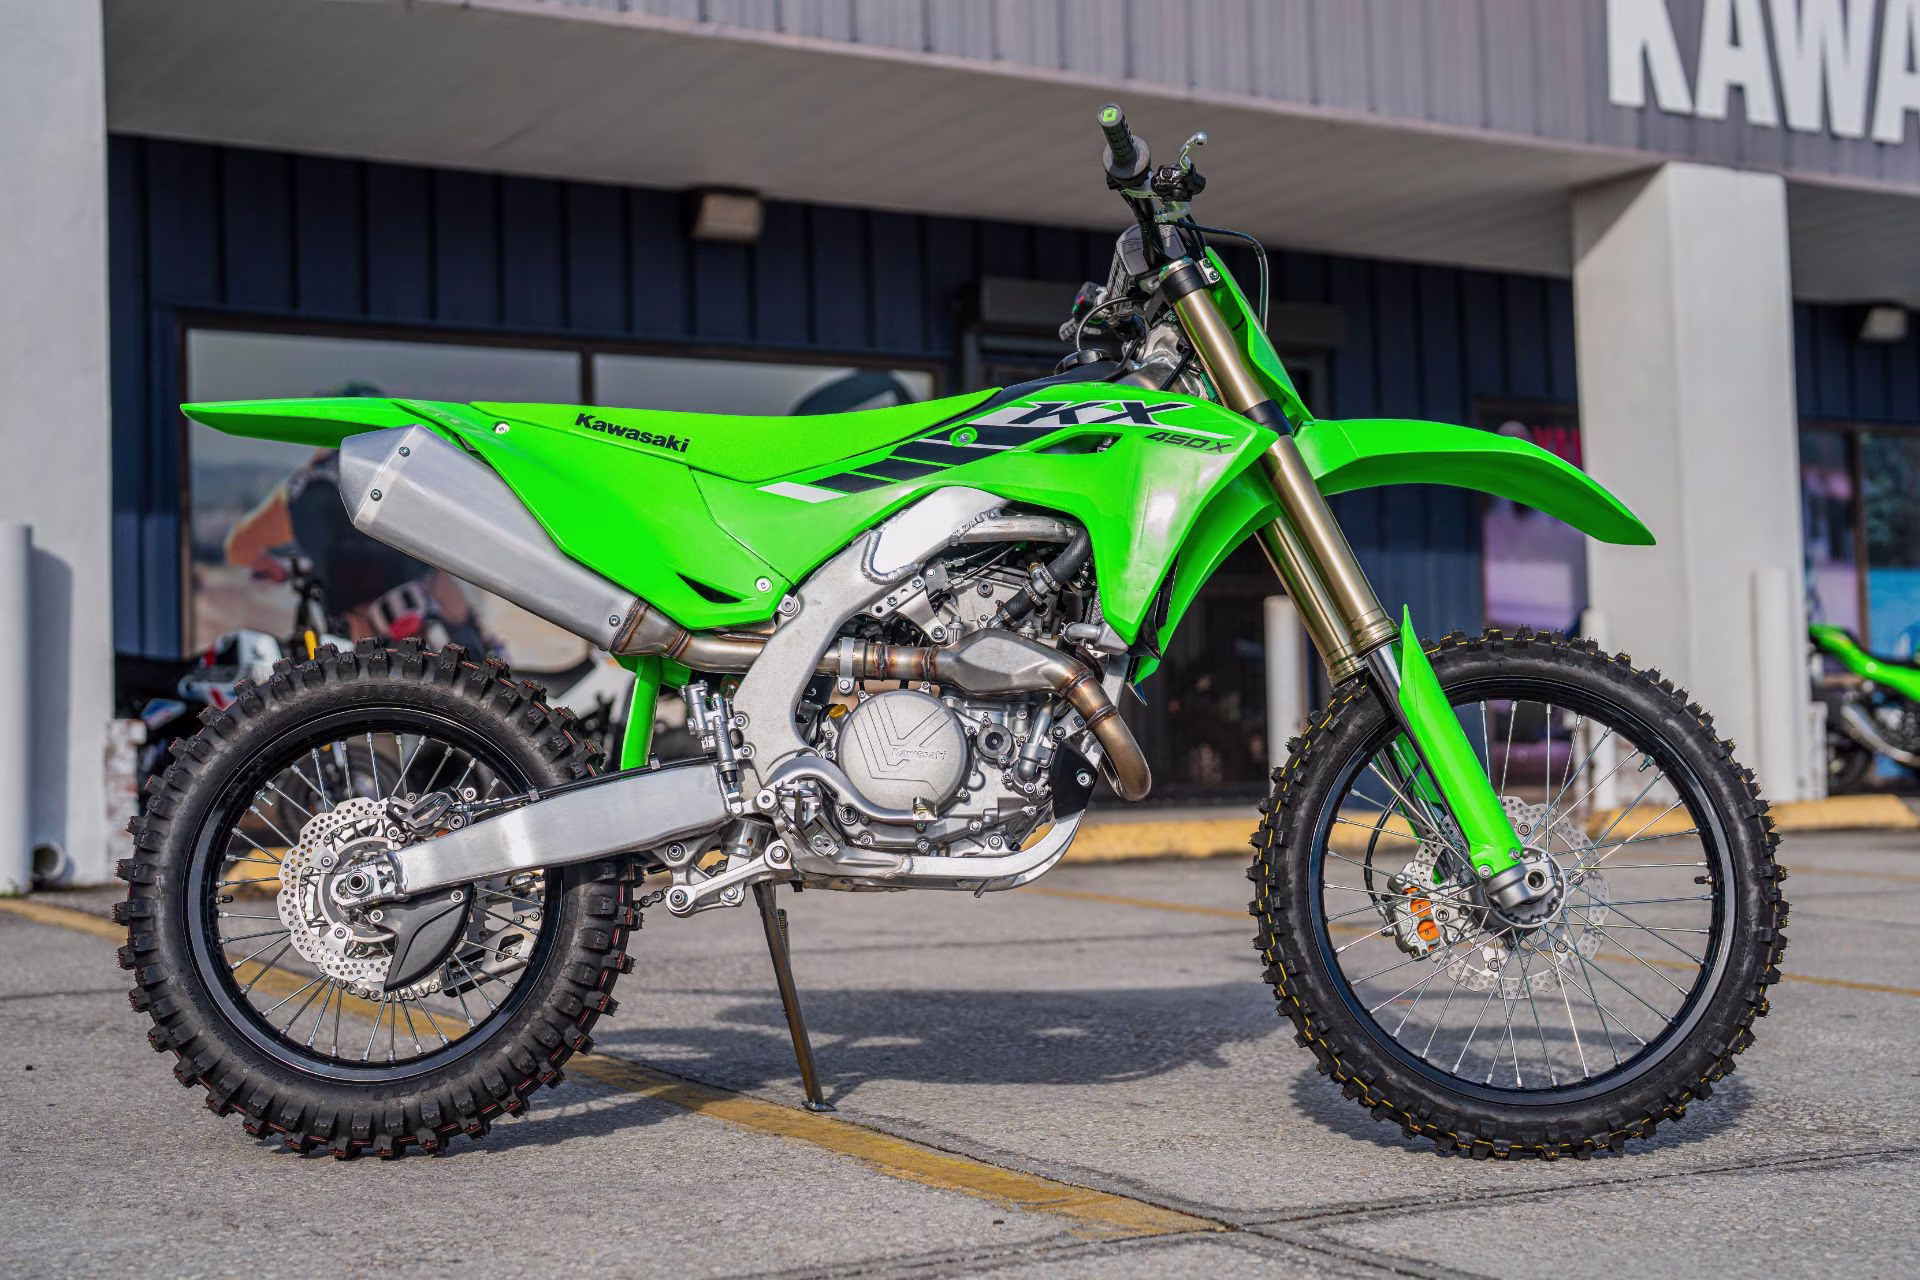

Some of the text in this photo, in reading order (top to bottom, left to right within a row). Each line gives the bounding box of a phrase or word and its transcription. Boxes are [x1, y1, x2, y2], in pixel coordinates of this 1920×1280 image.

[1007, 400, 1197, 426] KX
[574, 413, 690, 453] Kawasaki
[1144, 432, 1233, 453] 450X
[891, 747, 947, 760] Kawasaki
